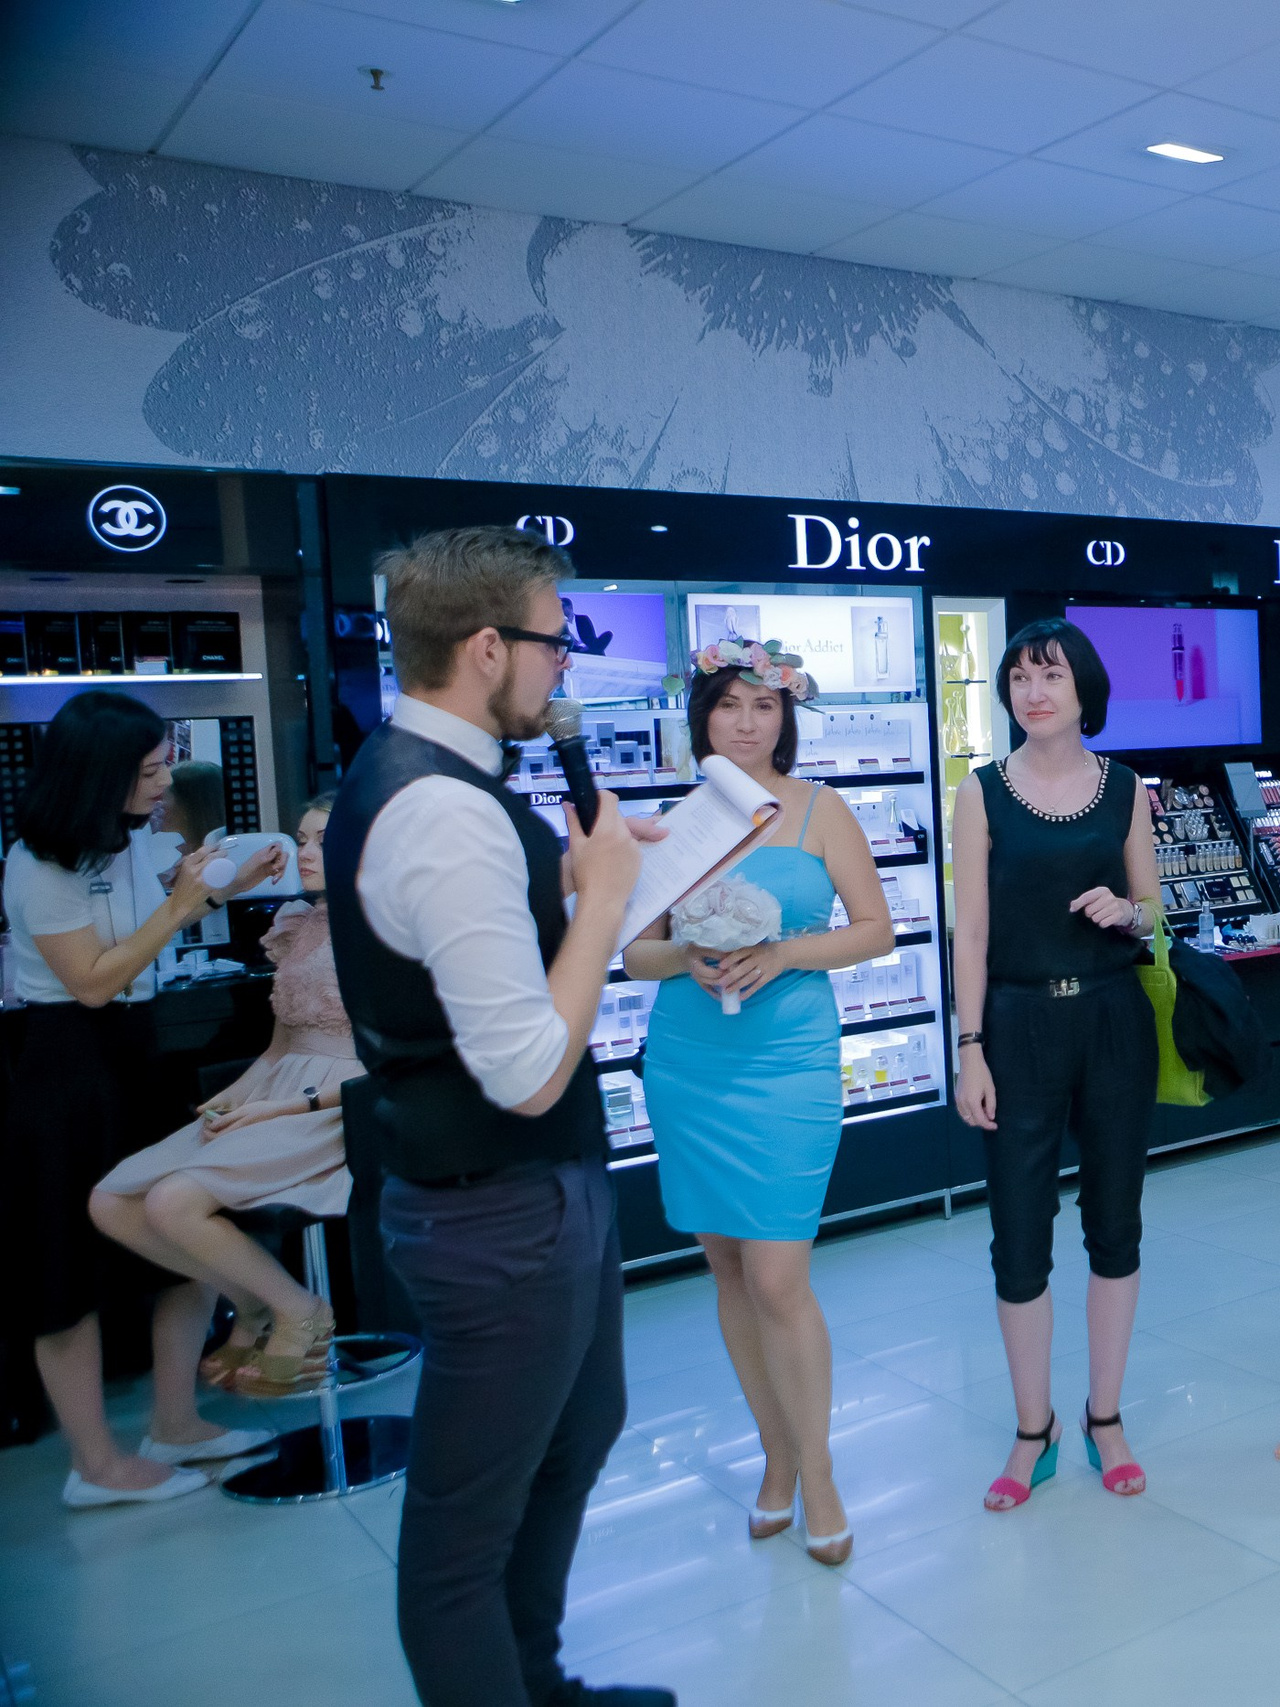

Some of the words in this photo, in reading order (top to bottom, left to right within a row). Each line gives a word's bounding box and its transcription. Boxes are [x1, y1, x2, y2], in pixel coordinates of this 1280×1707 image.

[787, 514, 931, 571] Dior
[1086, 540, 1125, 566] CD
[784, 641, 801, 653] ior
[804, 638, 844, 653] Addict
[531, 793, 562, 805] Dior
